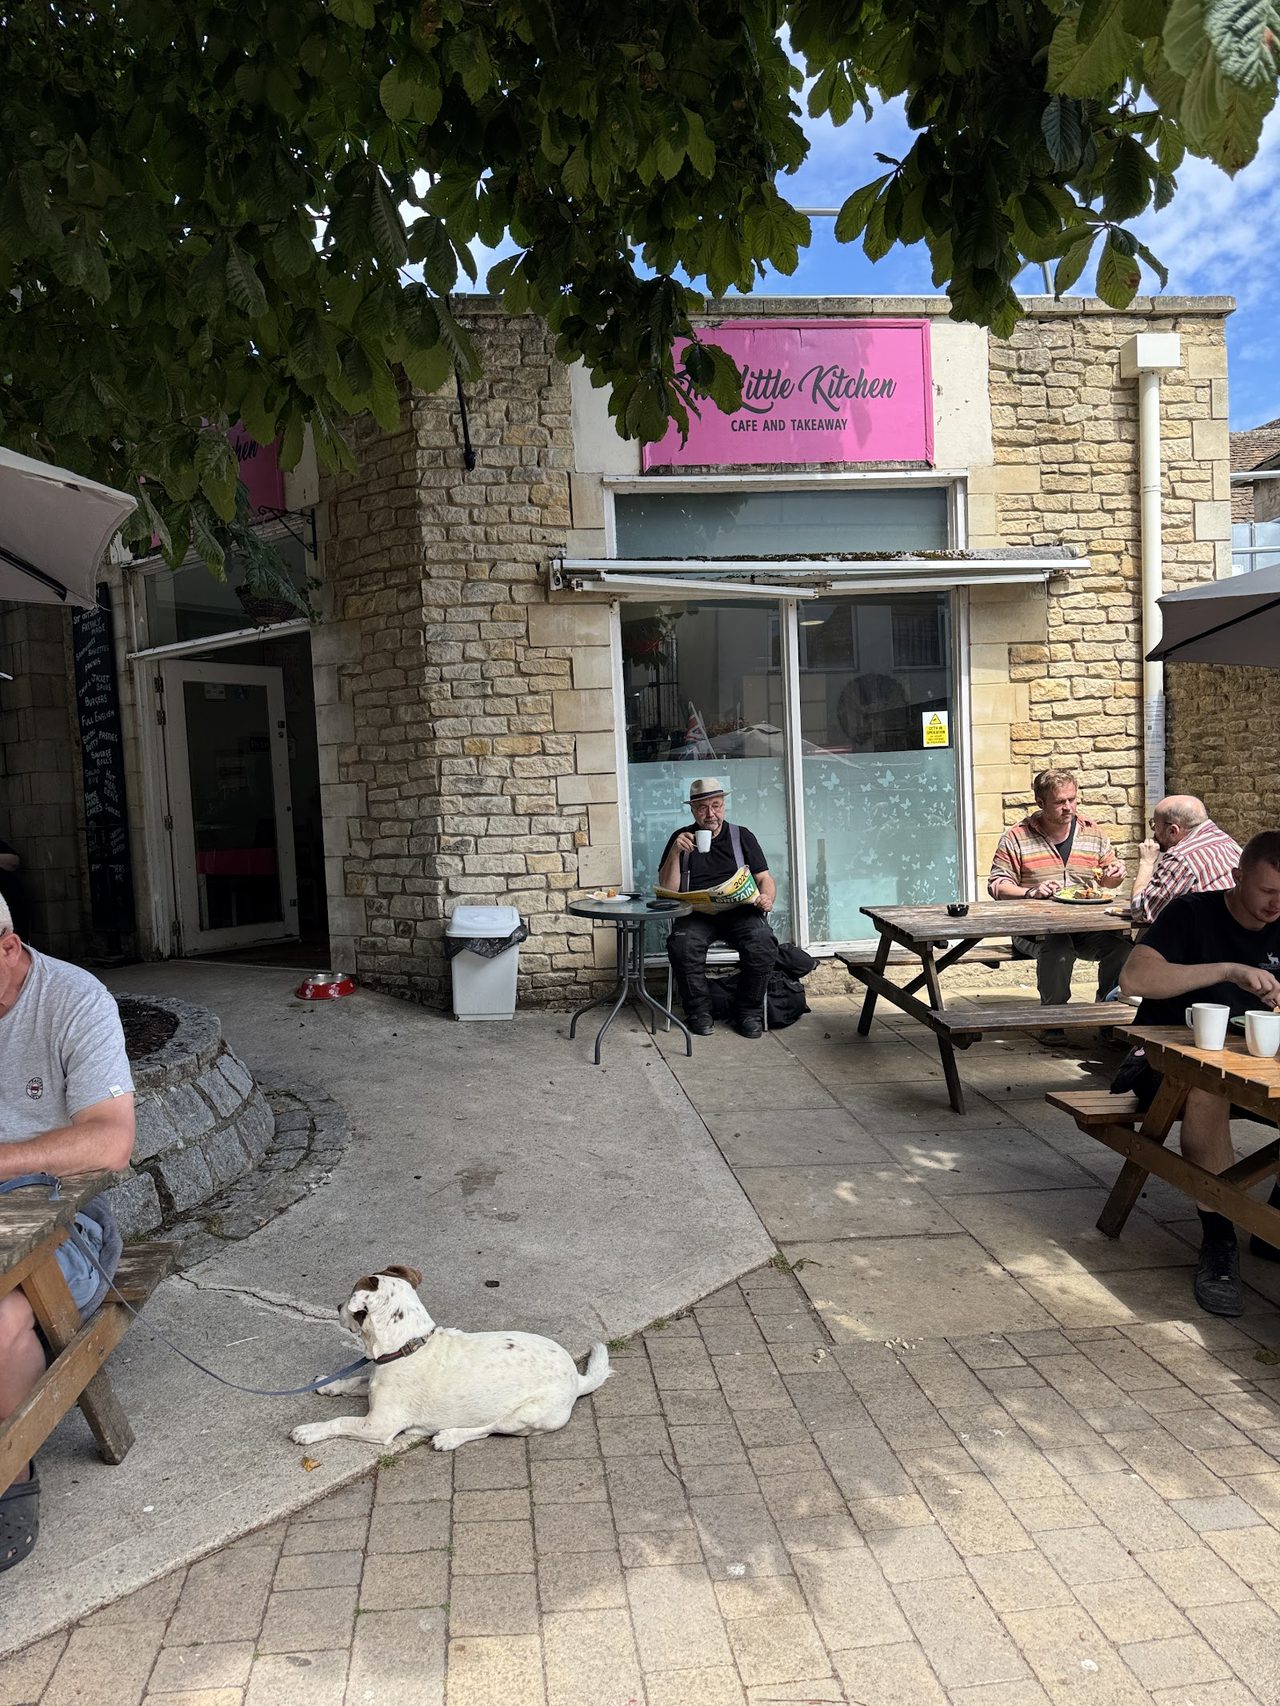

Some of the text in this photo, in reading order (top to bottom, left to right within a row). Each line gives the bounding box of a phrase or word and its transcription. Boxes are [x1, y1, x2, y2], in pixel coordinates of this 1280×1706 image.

[797, 364, 898, 412] Kitchen
[731, 418, 848, 432] CAFE AND TAKEAWAY
[84, 694, 108, 707] BURGERS
[81, 710, 115, 727] FULL ENGLISH
